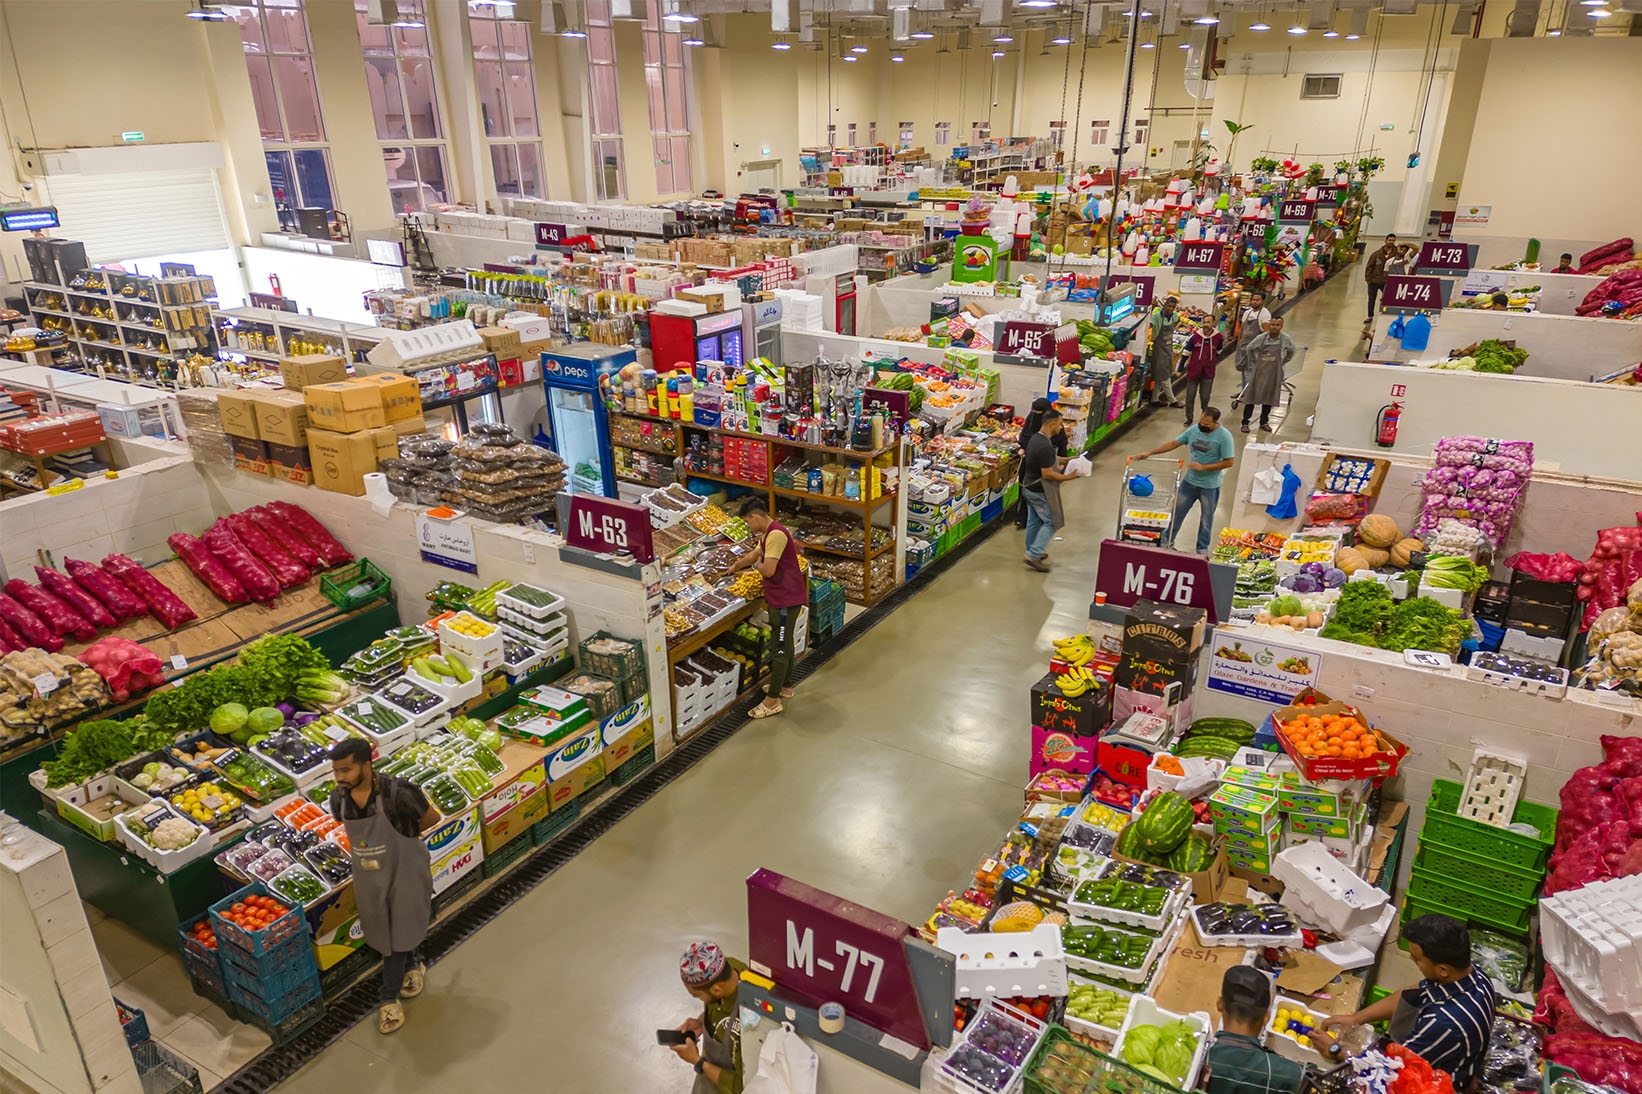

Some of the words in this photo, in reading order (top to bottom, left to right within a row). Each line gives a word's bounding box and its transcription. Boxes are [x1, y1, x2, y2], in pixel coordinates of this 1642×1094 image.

[1284, 204, 1307, 216] M-69
[541, 227, 559, 242] M-43
[1242, 223, 1266, 237] M-68
[1187, 248, 1215, 263] M-67
[1431, 248, 1462, 263] M-73
[1395, 283, 1431, 301] M-74
[1008, 328, 1042, 349] M-65
[578, 509, 628, 547] M-63
[1123, 562, 1195, 605] M-76
[1127, 623, 1187, 648] CITRUS
[1213, 670, 1234, 679] Glaze
[1236, 673, 1267, 686] Gardens
[1281, 684, 1302, 694] Tradi
[615, 703, 637, 722] Zain
[563, 737, 588, 757] Zain
[1115, 761, 1142, 778] CORE
[429, 820, 461, 845] Zain
[350, 925, 362, 936] ita
[786, 920, 884, 1004] M-77
[1172, 945, 1218, 963] resh
